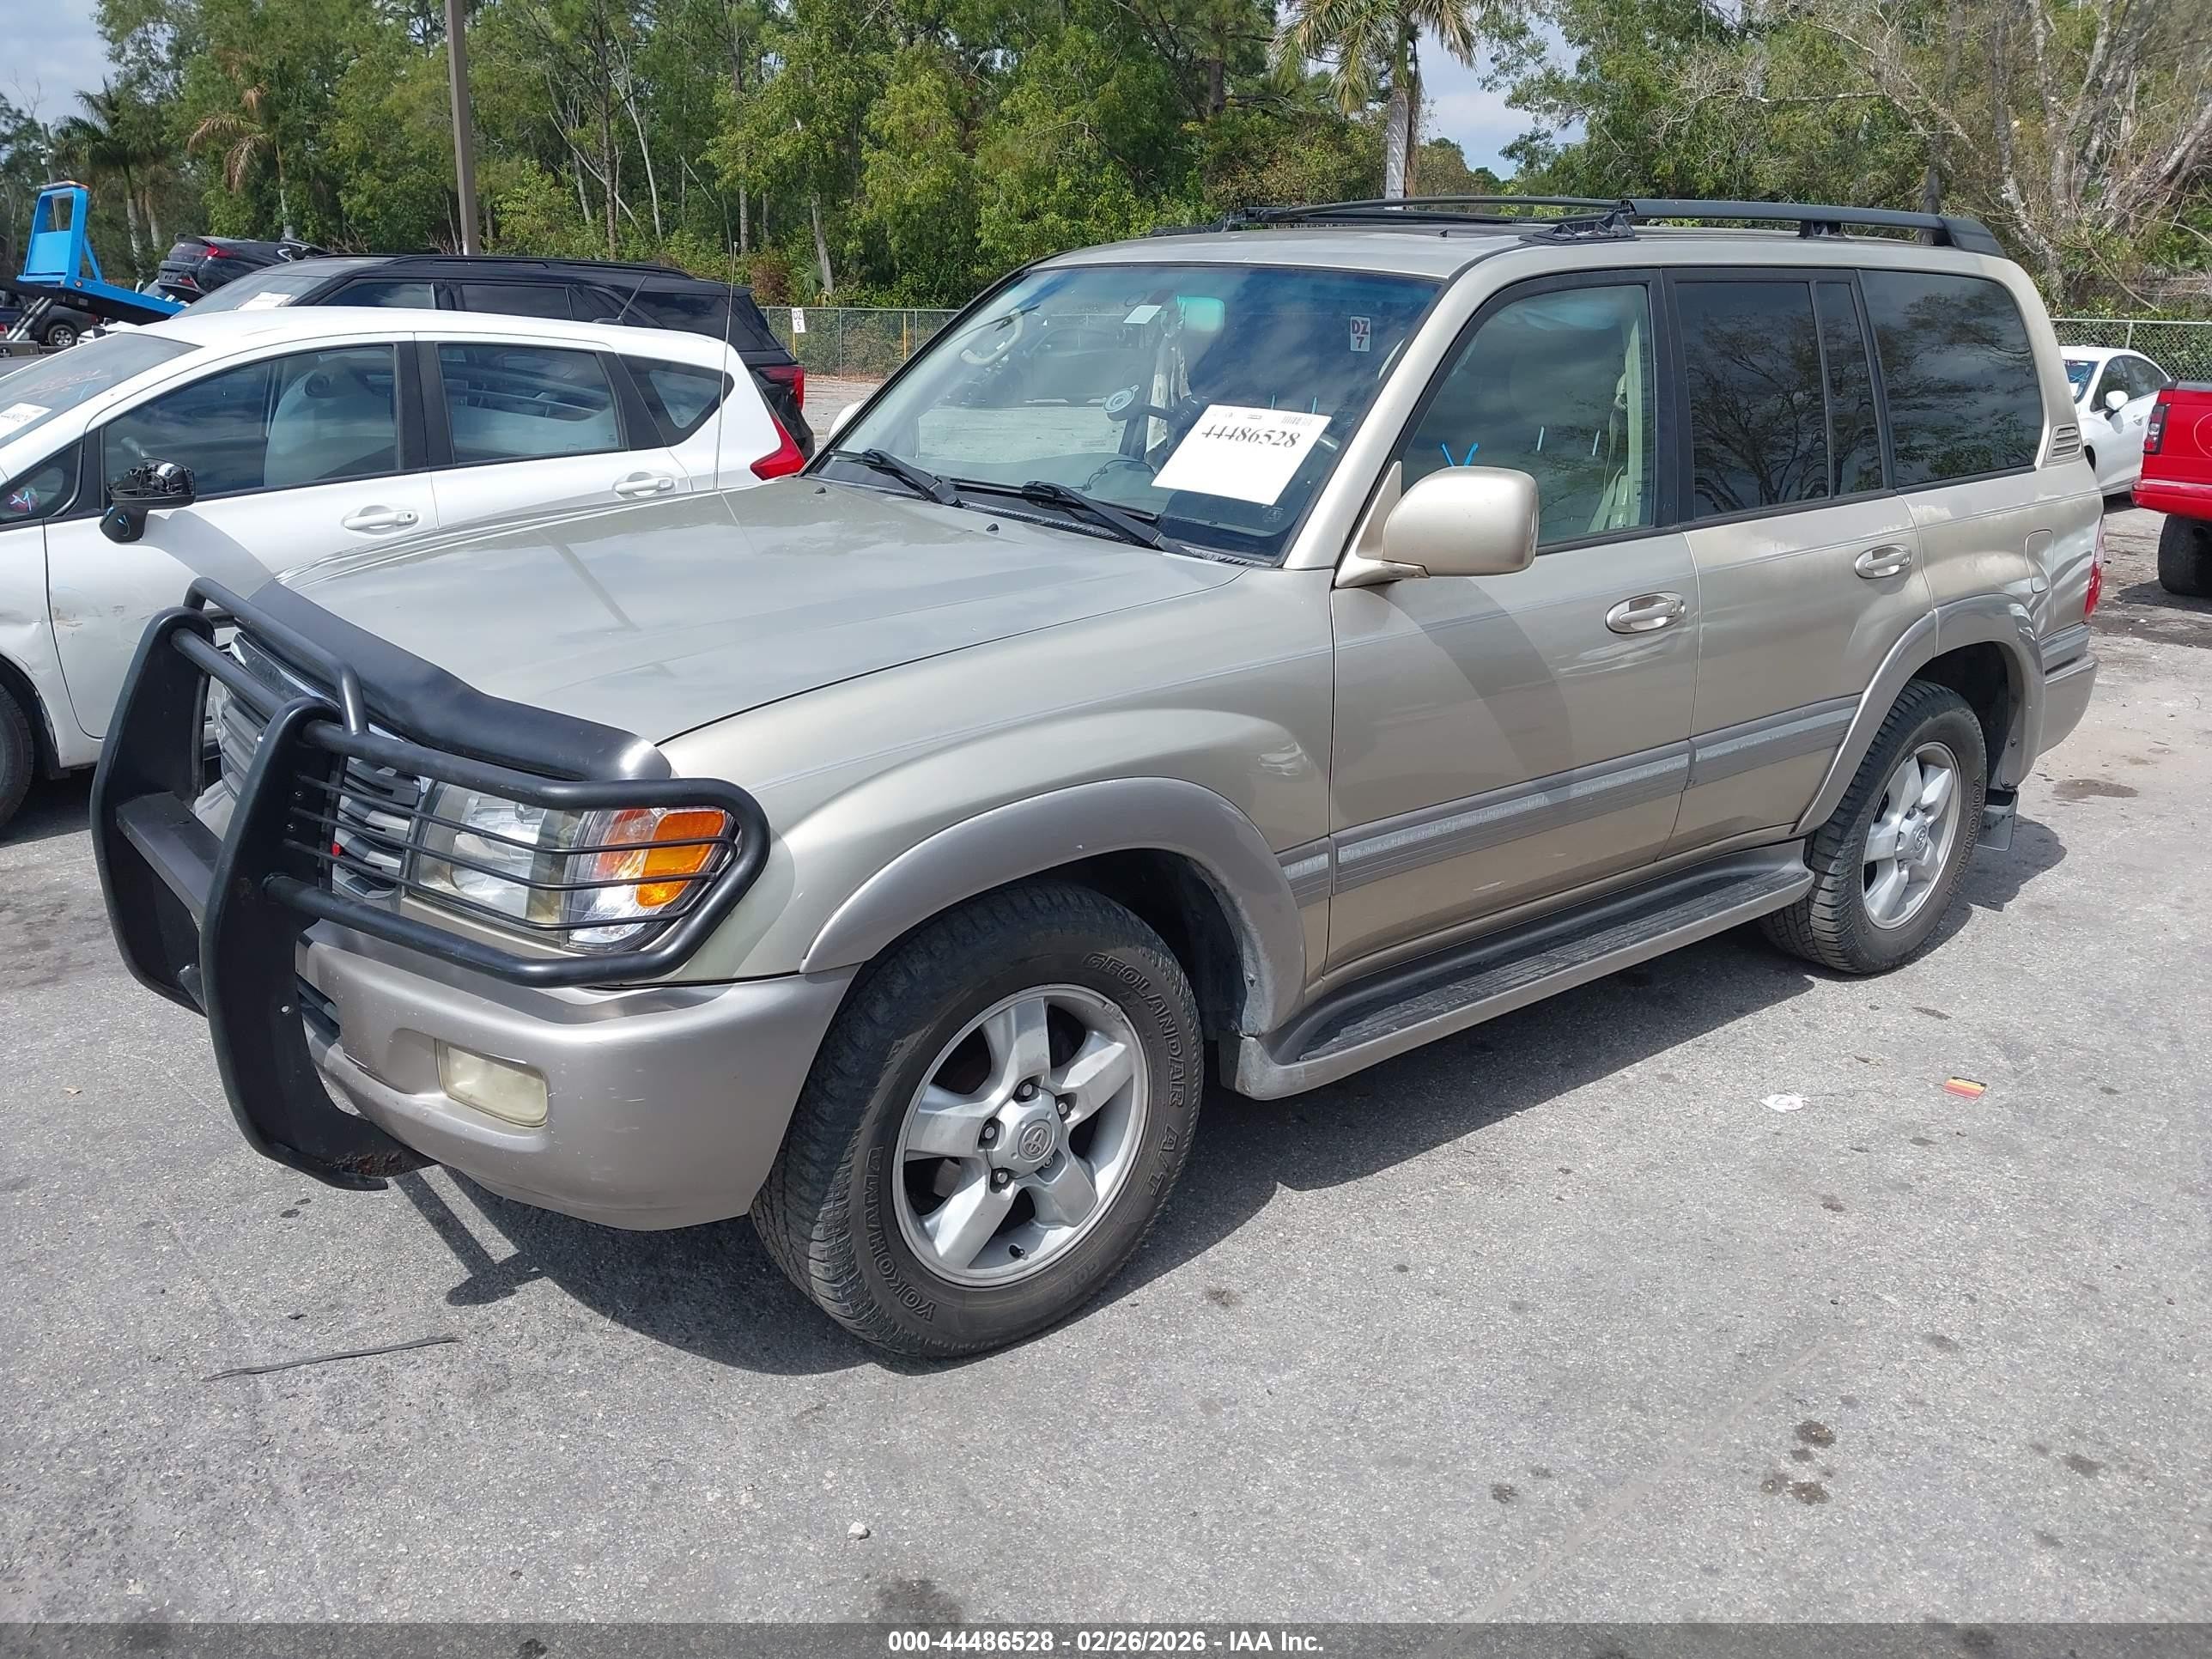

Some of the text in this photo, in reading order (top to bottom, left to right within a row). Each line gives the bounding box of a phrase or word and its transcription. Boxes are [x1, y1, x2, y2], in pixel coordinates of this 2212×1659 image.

[797, 321, 801, 331] 5
[1352, 319, 1370, 335] DZ
[1356, 336, 1364, 349] 7
[1201, 423, 1301, 448] 44486528
[1082, 951, 1186, 1197] GEOLANDAR A/T
[862, 1146, 937, 1322] YOKOHAMA
